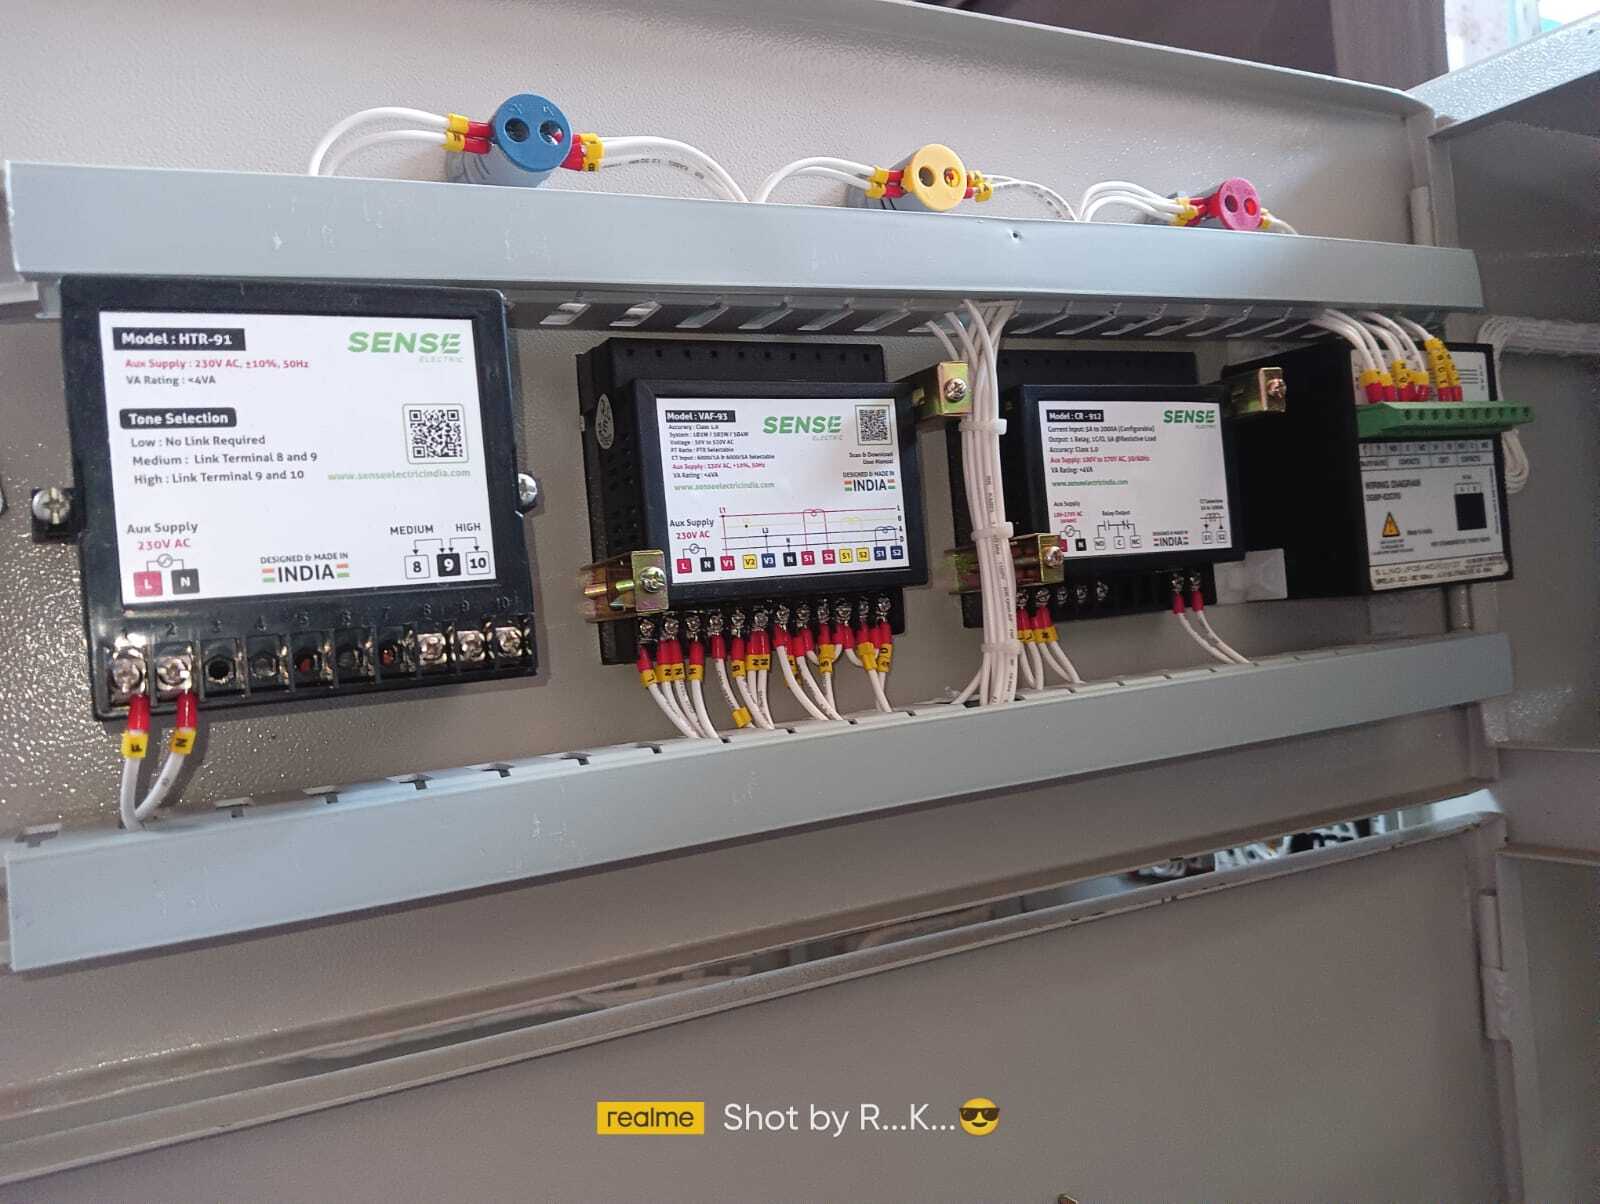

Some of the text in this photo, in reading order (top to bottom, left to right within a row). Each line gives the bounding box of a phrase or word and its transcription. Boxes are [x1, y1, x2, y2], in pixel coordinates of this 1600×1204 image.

[121, 333, 169, 346] Model
[178, 333, 233, 346] HTR-91
[348, 332, 462, 354] SENSE
[126, 360, 146, 368] Aux
[148, 360, 186, 371] Supply
[195, 360, 223, 368] 230V
[225, 360, 243, 370] AC,
[283, 360, 310, 369] 50Hz
[126, 376, 216, 387] VA Rating <4VA
[128, 412, 228, 425] Tone Selection
[666, 412, 693, 421] Model
[698, 412, 728, 421] VAF-93
[1163, 410, 1216, 424] SENSE
[763, 416, 842, 434] SENSE
[131, 435, 266, 448] Low No Link Required
[132, 452, 318, 466] Medium Link Terminal 8 and 9
[134, 470, 304, 487] High Link Terminal 9 and 10
[853, 479, 887, 492] INDIA
[126, 521, 199, 535] Aux Supply
[390, 522, 481, 536] MEDIUM HIGH
[687, 518, 714, 528] Supply
[676, 531, 697, 539] 230V
[1160, 537, 1183, 546] INDIA
[137, 538, 191, 551] 230V AC
[260, 554, 302, 565] DESIGNED
[313, 553, 338, 562] MADE
[412, 555, 487, 574] 8 9 10
[721, 559, 733, 567] V1
[745, 558, 755, 566] V2
[842, 552, 851, 560] S1
[278, 564, 336, 583] INDIA
[144, 576, 190, 589] L N
